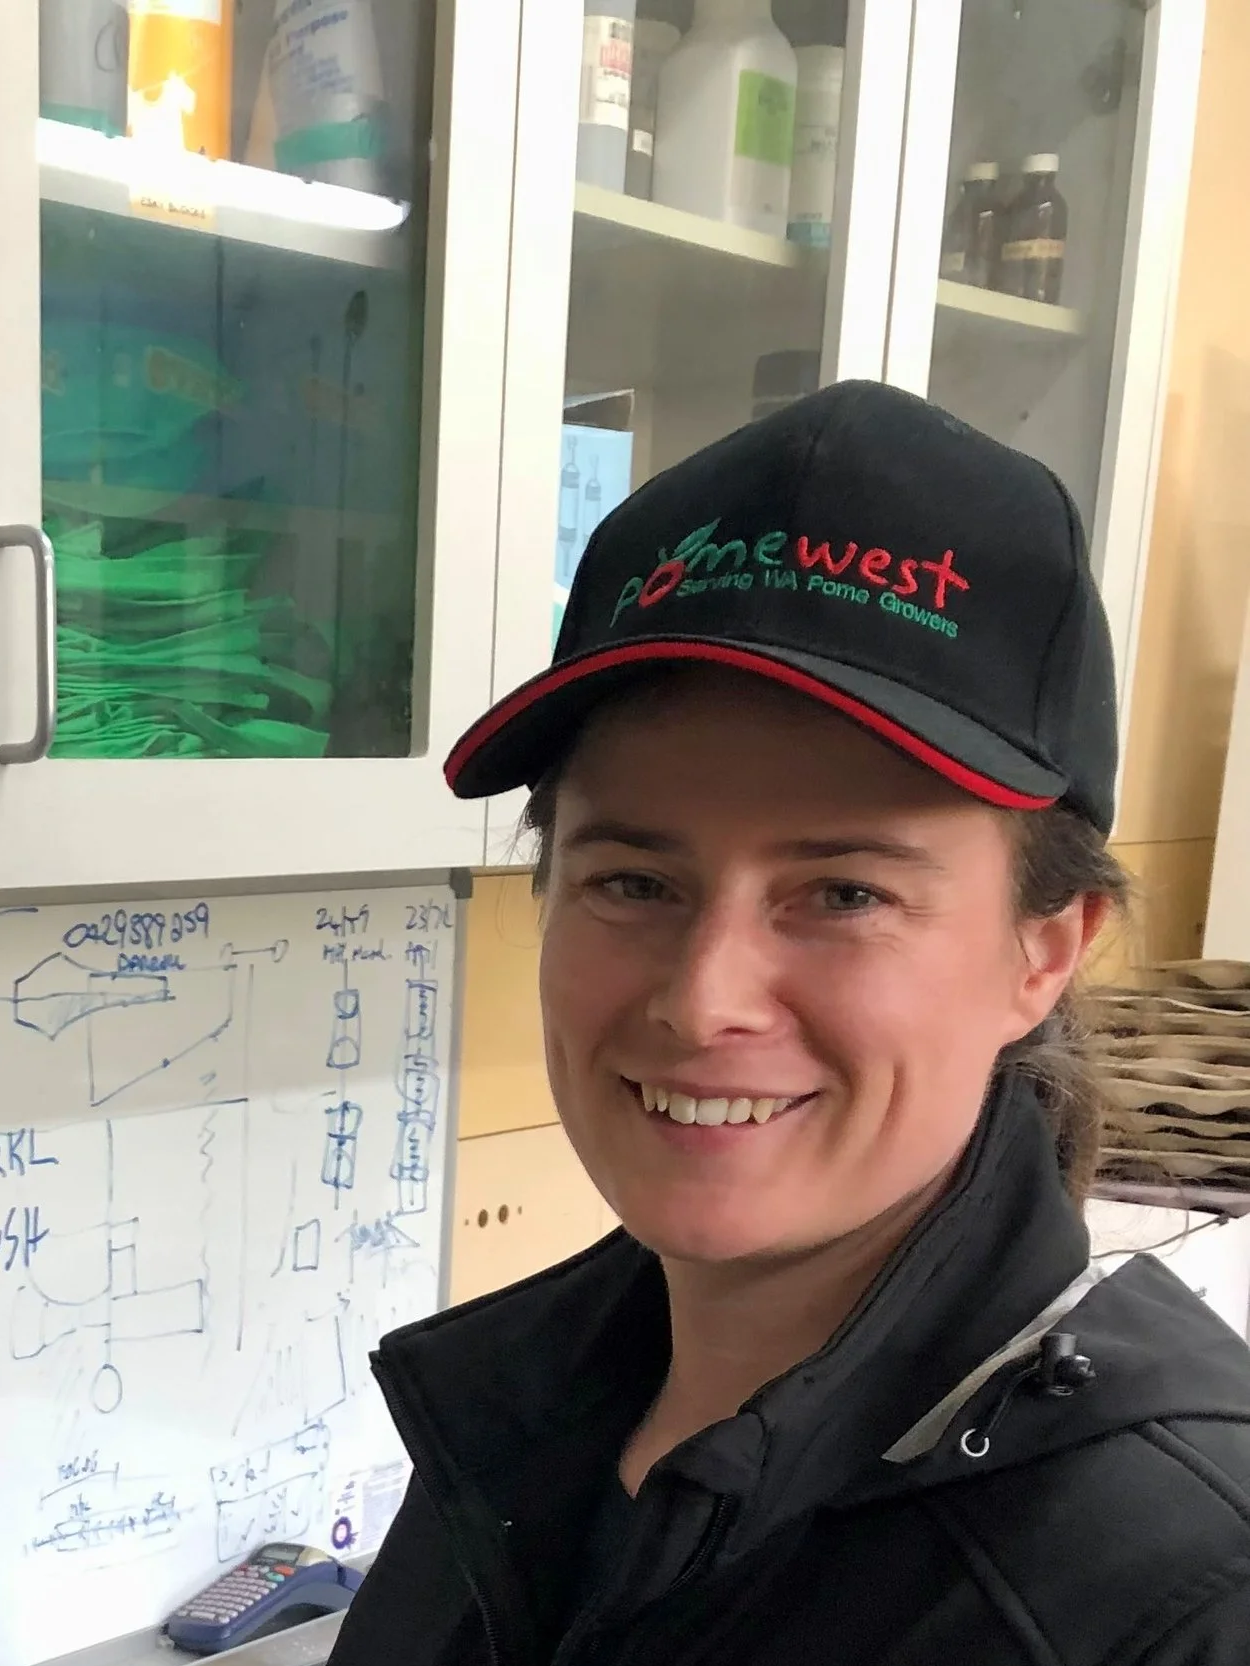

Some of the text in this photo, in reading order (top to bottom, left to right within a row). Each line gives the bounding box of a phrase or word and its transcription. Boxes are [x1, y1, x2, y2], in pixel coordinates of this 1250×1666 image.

[675, 570, 960, 639] Serving WA Pome Growers
